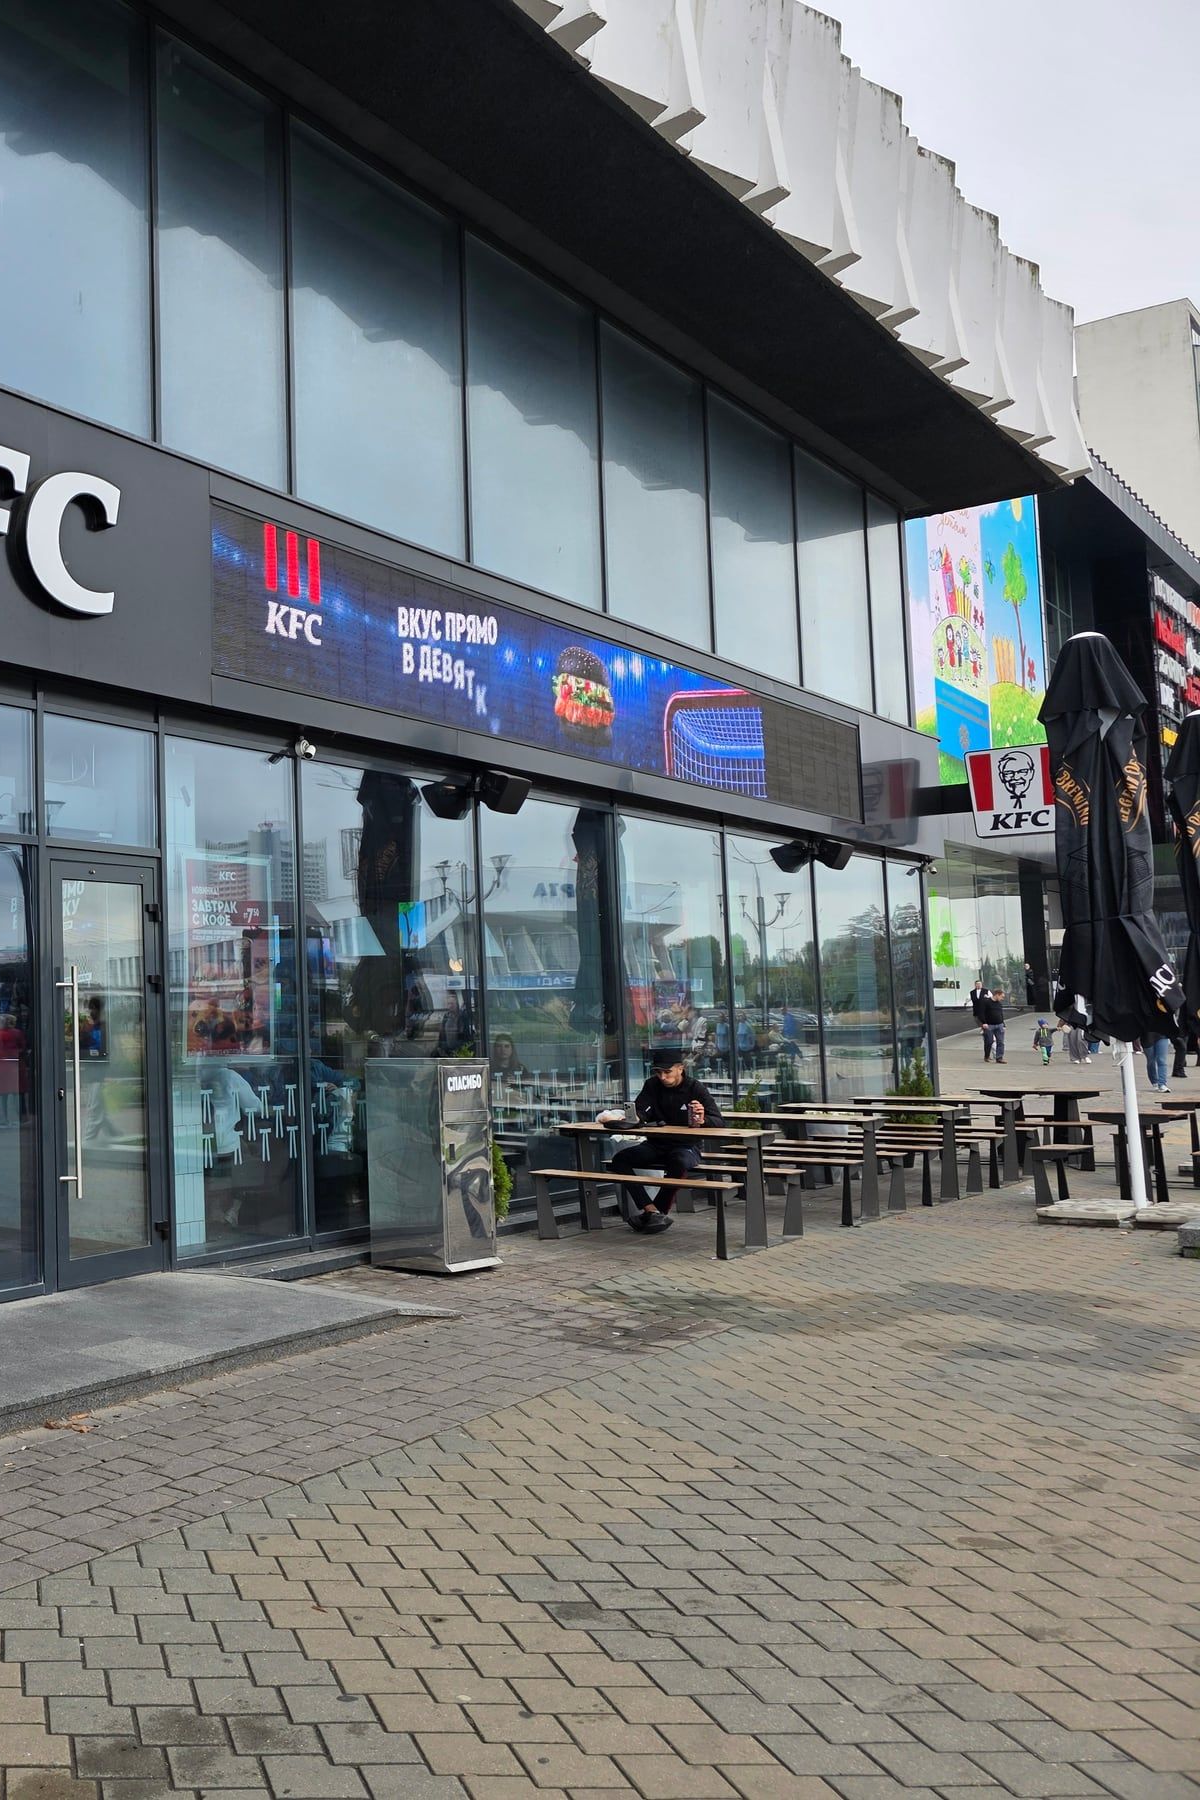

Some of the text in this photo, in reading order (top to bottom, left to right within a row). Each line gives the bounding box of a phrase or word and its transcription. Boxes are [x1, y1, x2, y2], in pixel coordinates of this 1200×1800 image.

[265, 600, 323, 646] KFC
[398, 606, 498, 645] ВКУС ПРЯМО
[402, 642, 415, 674] В
[989, 809, 1050, 831] KFC
[219, 871, 237, 881] KFC
[191, 899, 238, 914] ЗАВТРАК
[192, 914, 232, 927] С КОФЕ
[447, 1073, 482, 1092] СПАСИБО
